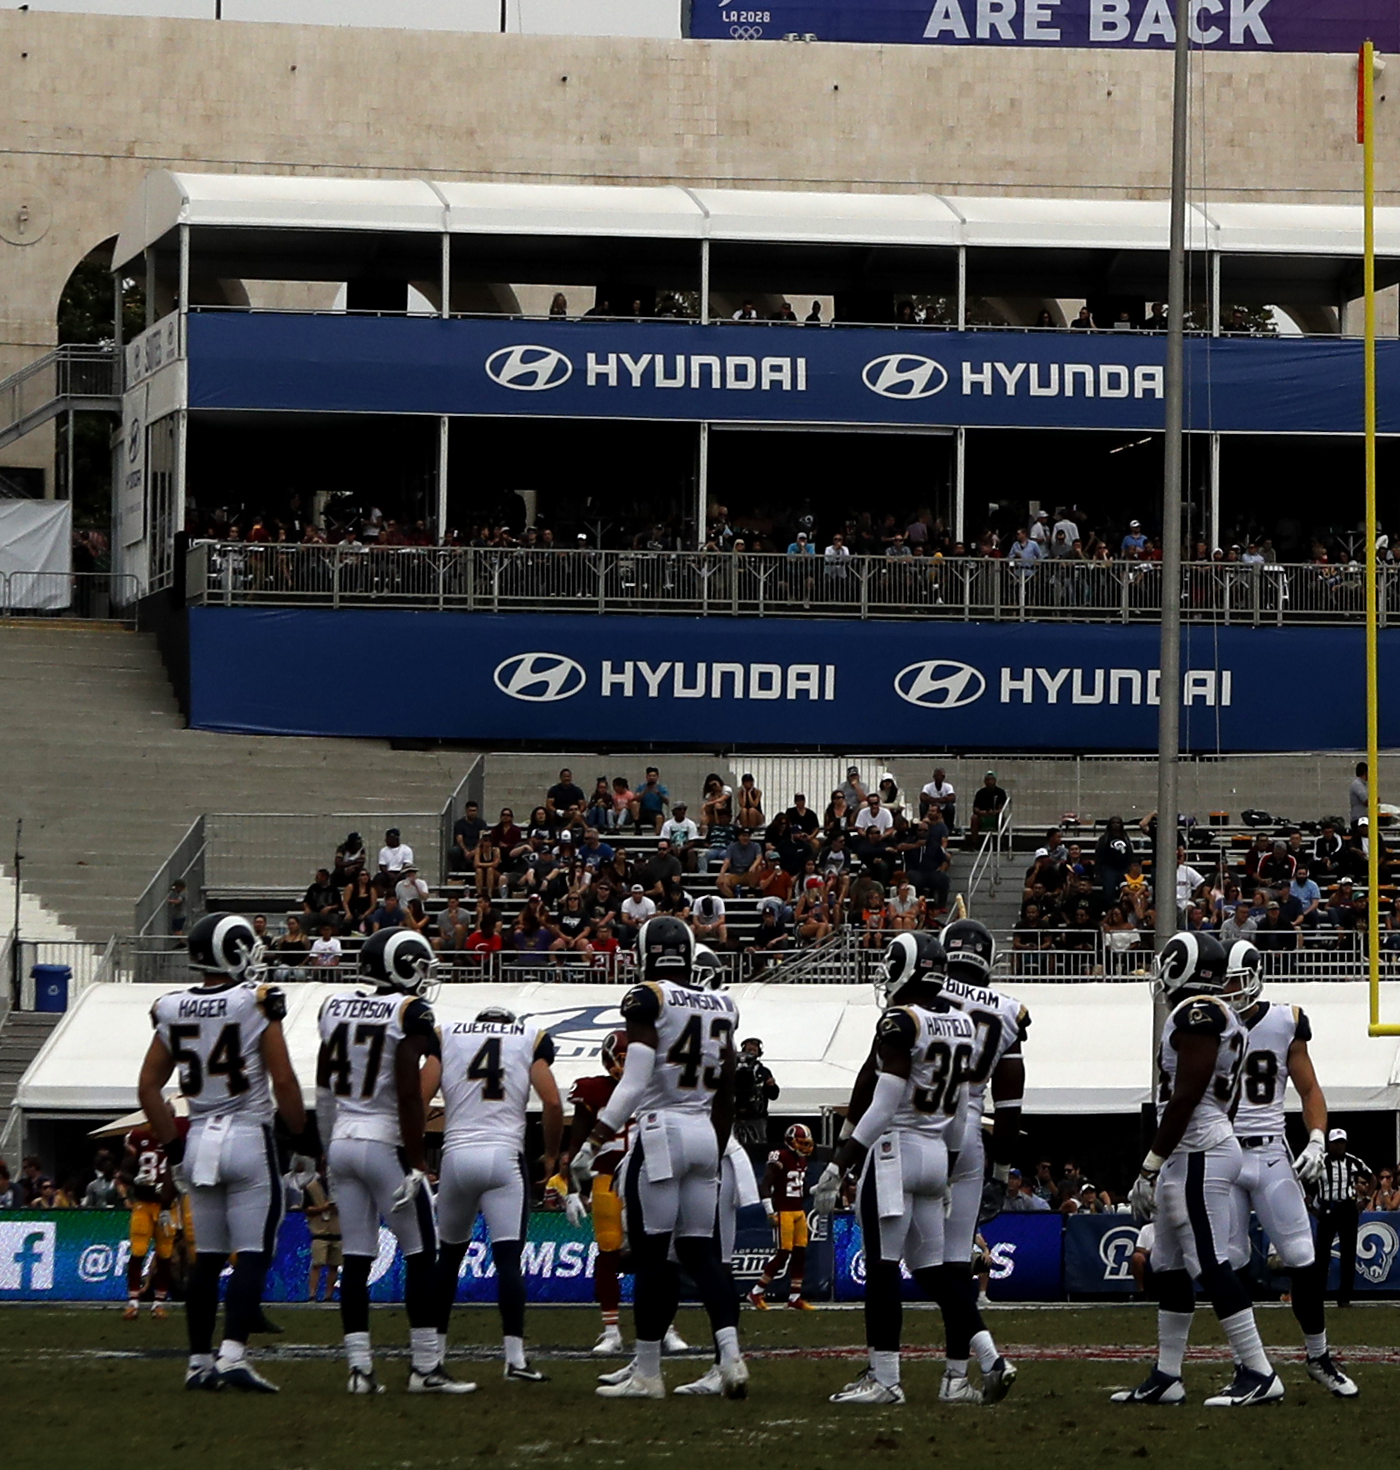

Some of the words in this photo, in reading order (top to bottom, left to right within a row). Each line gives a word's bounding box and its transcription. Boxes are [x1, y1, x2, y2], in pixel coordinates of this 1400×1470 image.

[722, 10, 738, 23] LA
[739, 10, 771, 23] 2028
[585, 351, 807, 392] HYUNDAI
[961, 360, 1168, 399] HYUNDA
[600, 659, 836, 701] HYUNDAI
[178, 998, 228, 1019] HAGER
[325, 998, 397, 1020] PETERSON
[668, 990, 725, 1012] JOHNSON
[945, 977, 999, 1009] BUKAM
[452, 1021, 525, 1036] ZUERLEIN
[926, 1018, 972, 1039] HATFIELD
[169, 1023, 250, 1097] 54
[325, 1023, 388, 1099] 47
[467, 1037, 506, 1102] 4
[1246, 1050, 1278, 1104] 8
